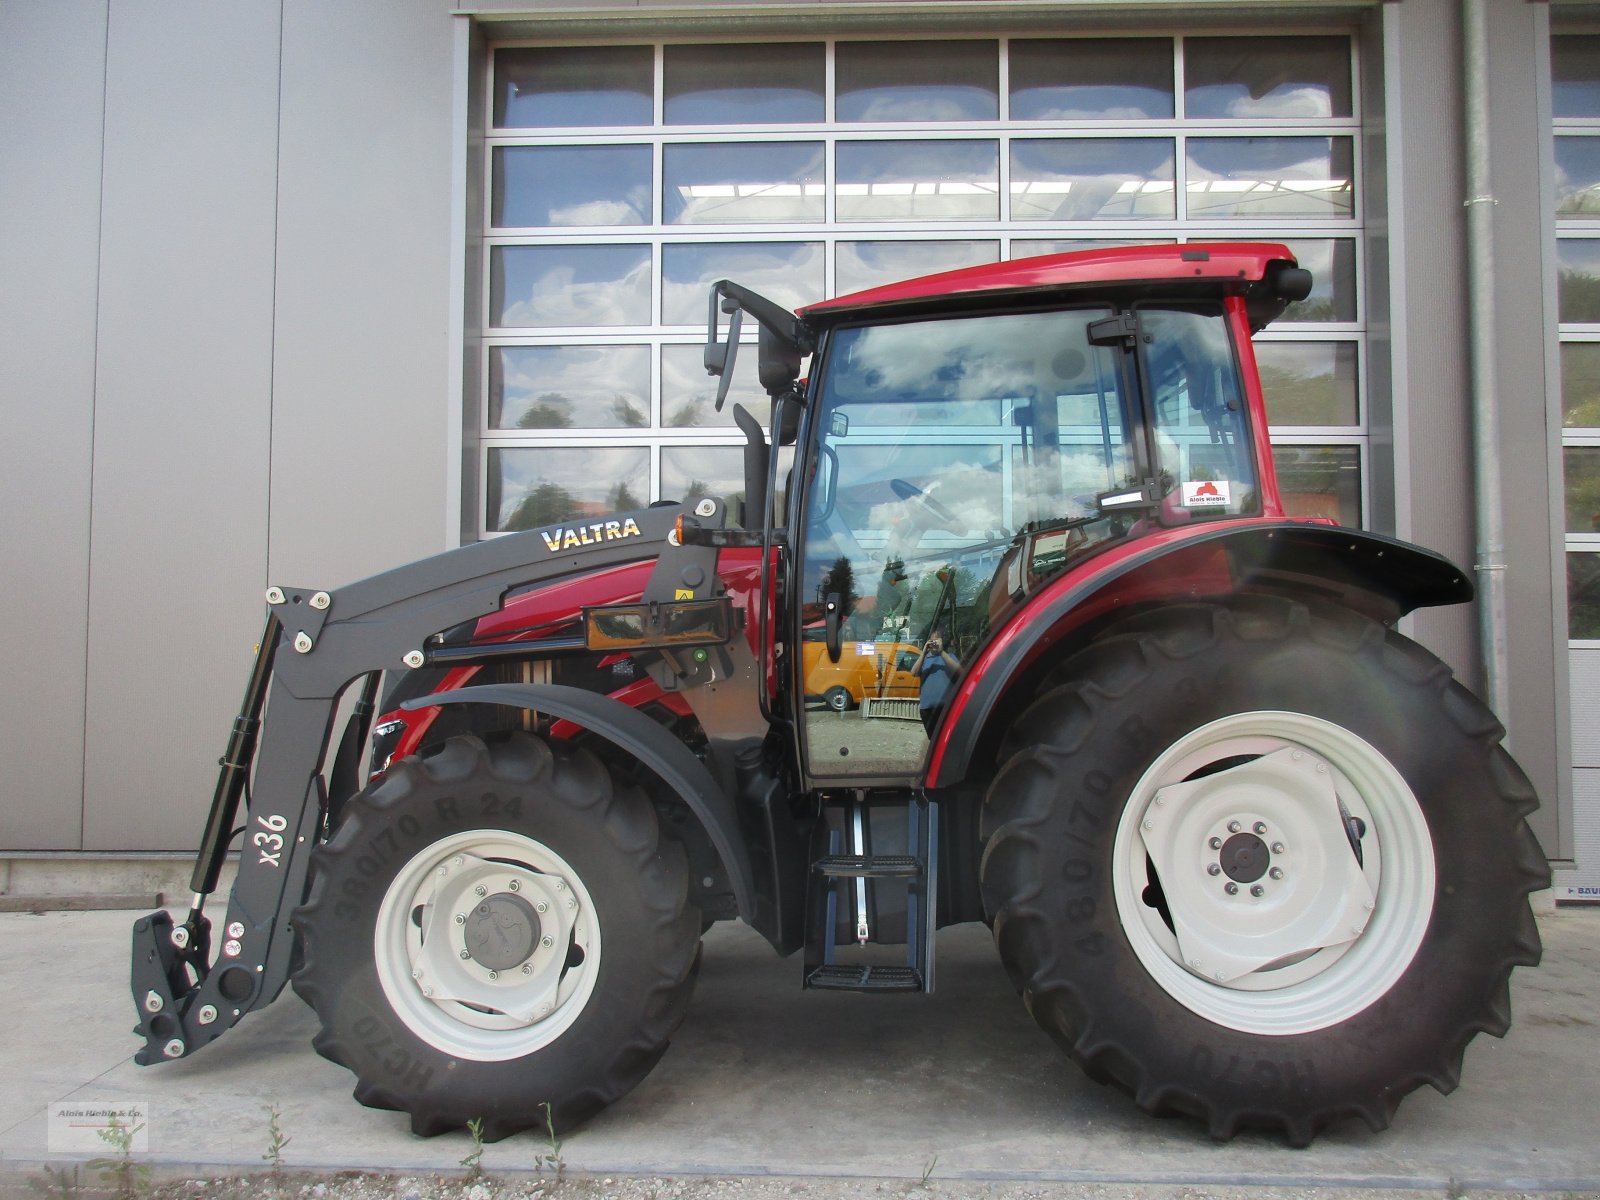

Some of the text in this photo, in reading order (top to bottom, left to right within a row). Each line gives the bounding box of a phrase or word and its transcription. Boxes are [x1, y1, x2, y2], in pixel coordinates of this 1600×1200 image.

[541, 517, 640, 552] VALTRA
[334, 792, 524, 921] 380/70 R 24
[1062, 769, 1112, 955] 480/70
[1577, 887, 1600, 895] BAU
[353, 1015, 436, 1091] HC70
